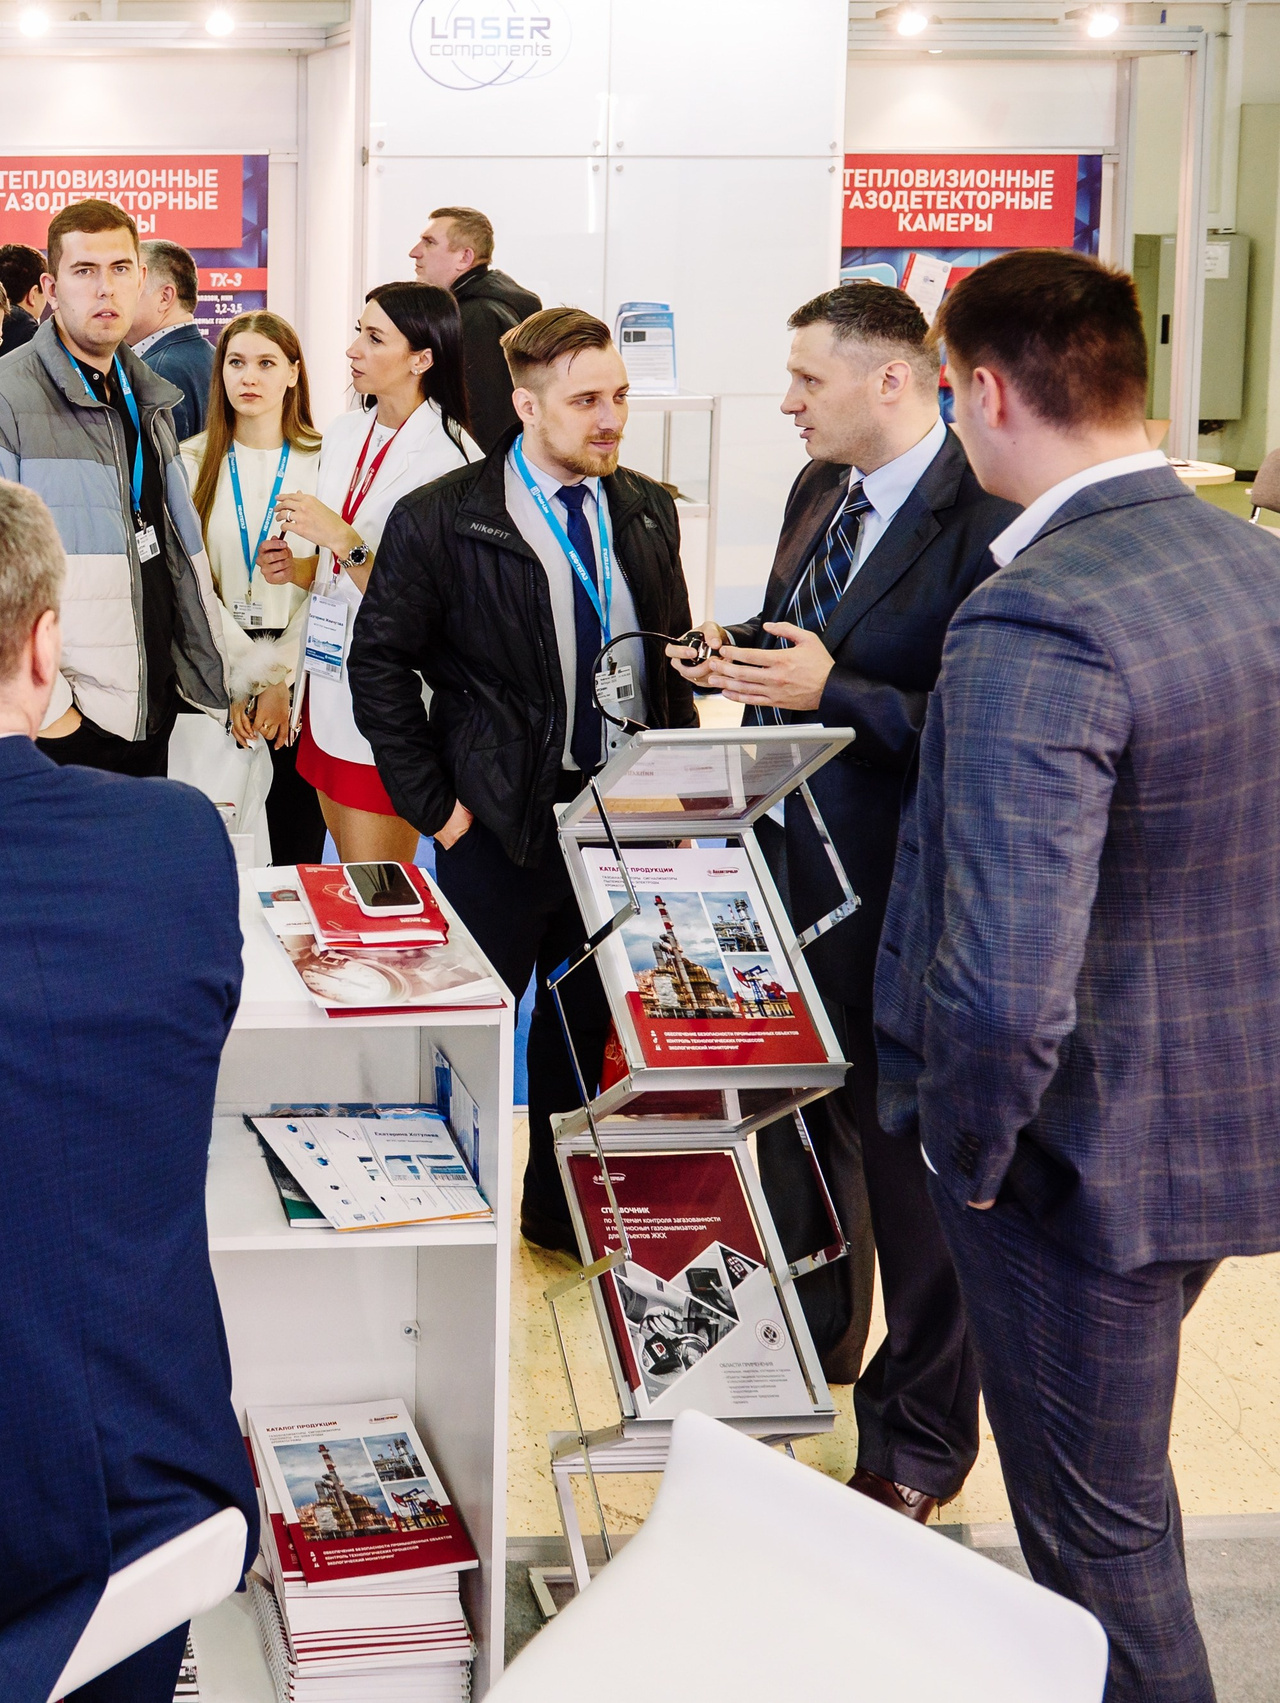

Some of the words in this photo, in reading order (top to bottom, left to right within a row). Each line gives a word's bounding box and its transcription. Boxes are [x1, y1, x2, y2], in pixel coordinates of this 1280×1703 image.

[431, 16, 551, 39] LASER
[429, 42, 552, 59] components
[843, 169, 1055, 188] ТЕПЛОВИЗИОННЫЕ
[898, 213, 993, 232] КАМЕРЫ
